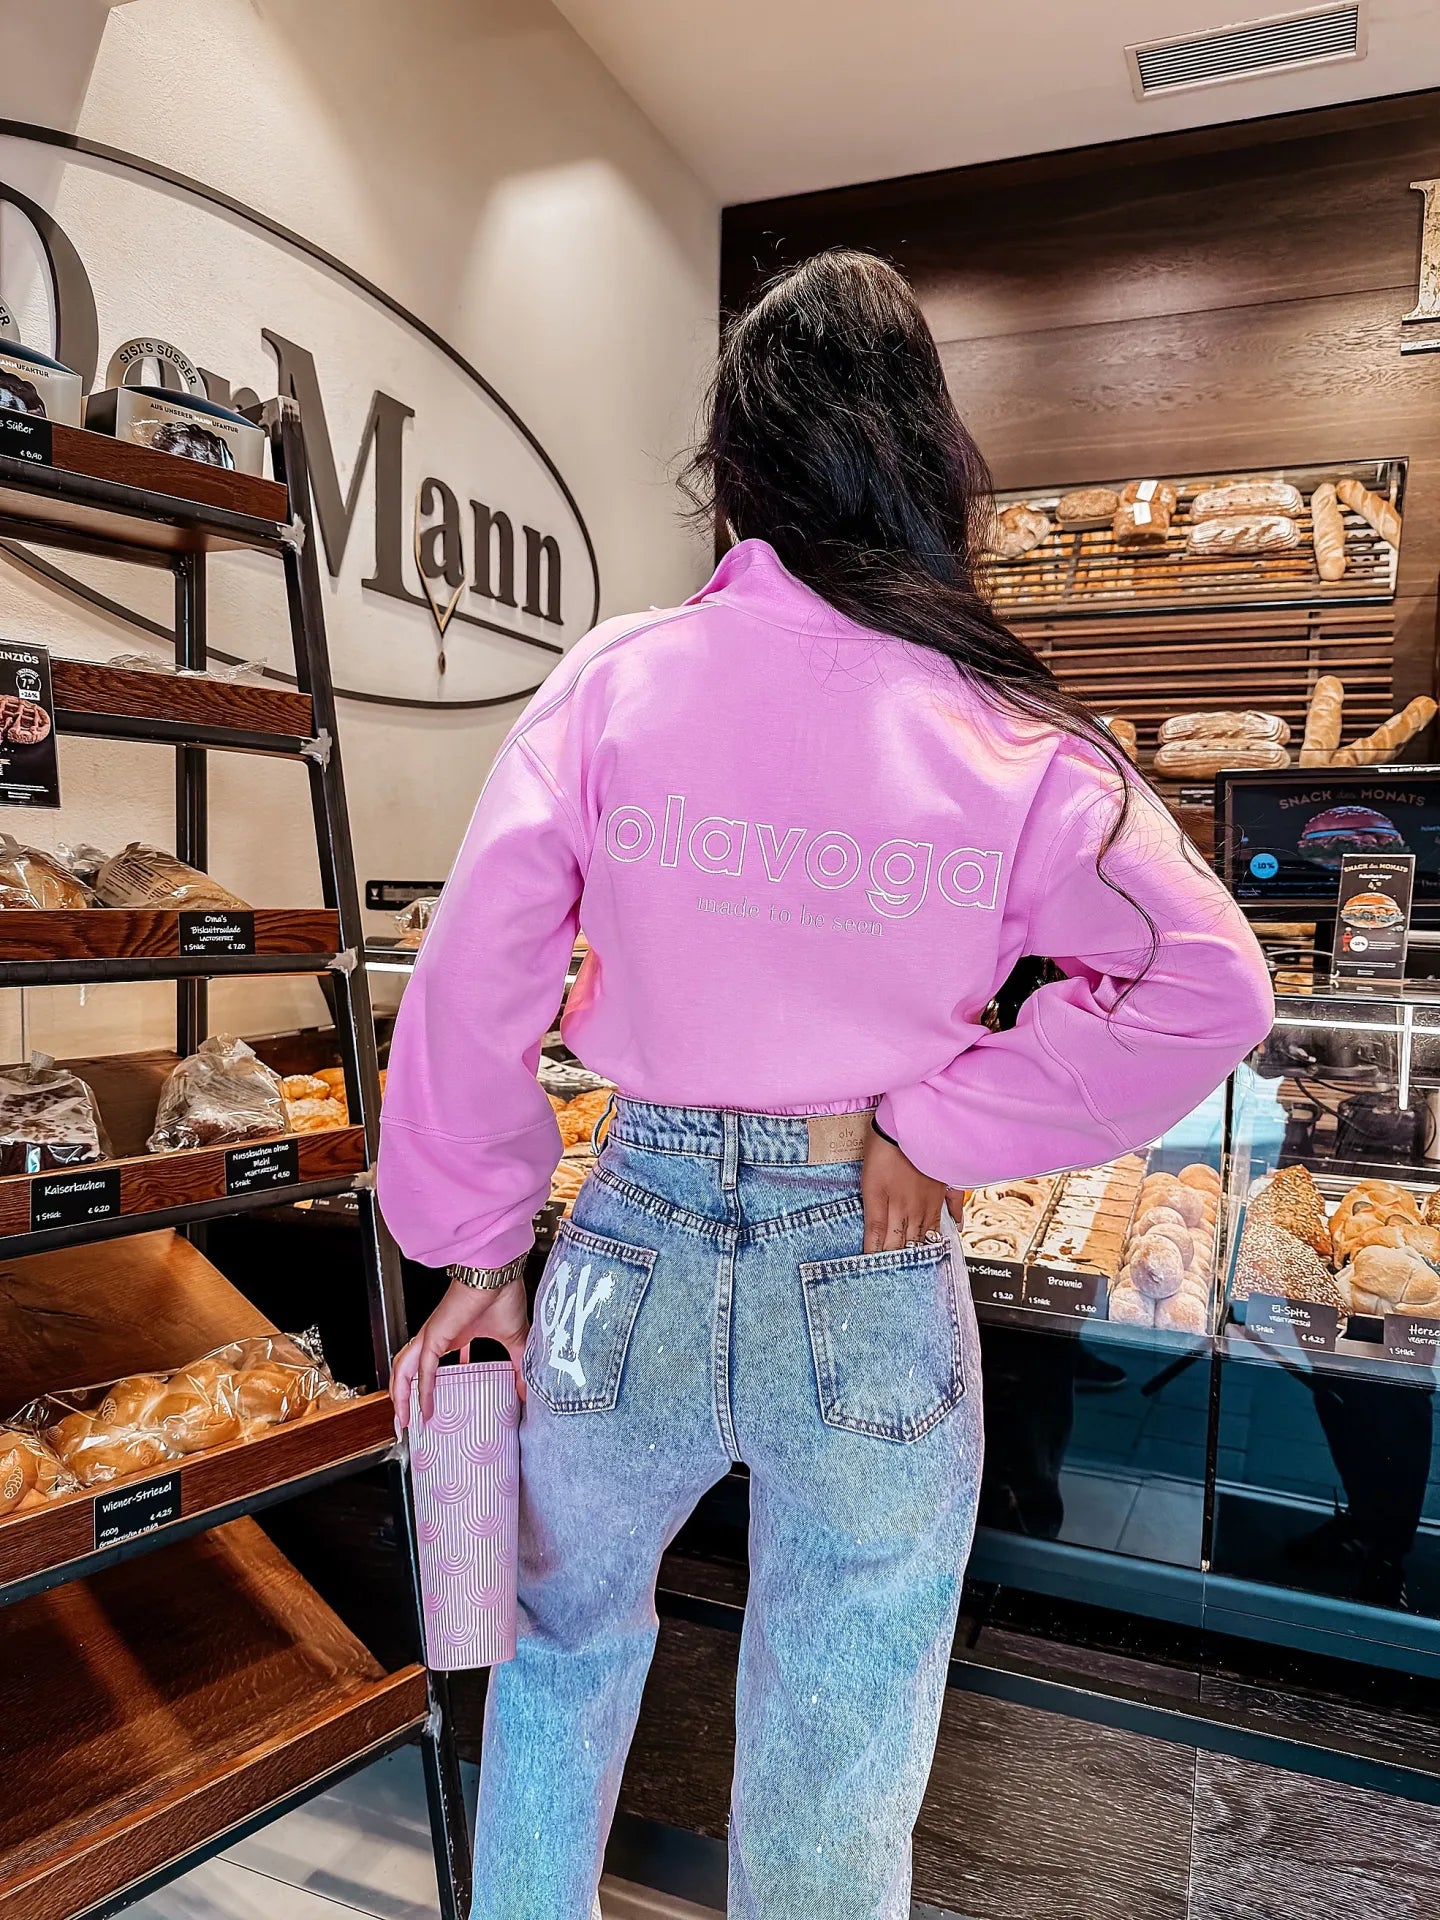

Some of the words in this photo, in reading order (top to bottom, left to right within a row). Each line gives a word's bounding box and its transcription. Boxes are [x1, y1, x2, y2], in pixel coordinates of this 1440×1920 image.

[119, 342, 154, 364] SISI'S
[157, 344, 198, 386] SÜSSER
[262, 328, 564, 626] Mann
[1279, 790, 1332, 809] SNACK
[1361, 789, 1426, 807] MONATS
[605, 794, 1004, 919] olavoga
[1343, 863, 1369, 872] SNACK
[1379, 863, 1409, 873] MONATS
[204, 914, 228, 923] Oma's
[696, 896, 761, 919] made
[769, 904, 792, 924] to
[800, 904, 825, 929] be
[832, 915, 885, 937] seen
[273, 1144, 289, 1153] ohne
[253, 1156, 270, 1167] Mehl
[44, 1180, 106, 1196] Kaiserkuchen
[41, 1210, 62, 1221] Stück
[102, 1481, 172, 1513] Wiener-Striezel
[99, 1526, 119, 1538] 400g
